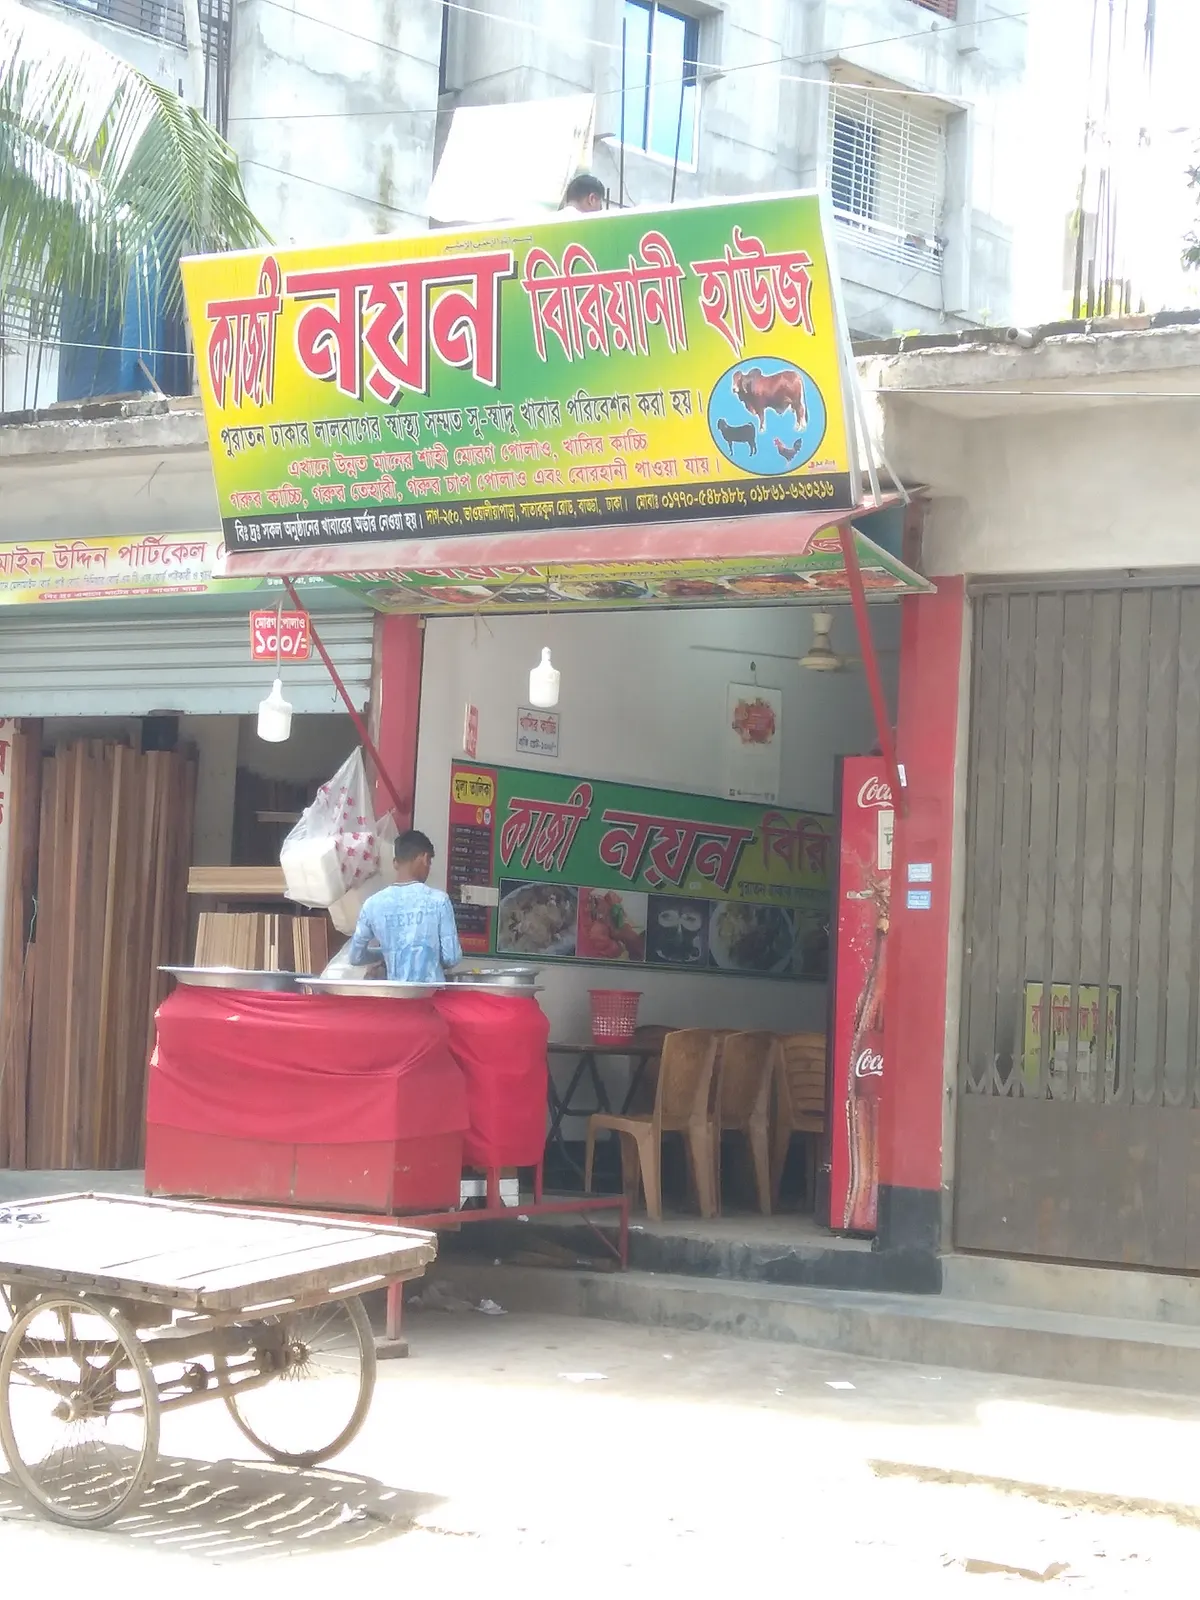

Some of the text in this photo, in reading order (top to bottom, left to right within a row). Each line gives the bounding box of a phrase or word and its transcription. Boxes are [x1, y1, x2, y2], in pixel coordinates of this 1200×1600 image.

[206, 225, 815, 409] কাজী নয়ন বিরিয়ানী হাউজ
[221, 425, 265, 457] পুরাতন
[269, 420, 310, 448] ঢাকার
[313, 416, 381, 446] লালবাগের
[384, 411, 420, 446] স্বাস্থ্য
[423, 408, 463, 438] সম্মত
[466, 402, 519, 439] সু-স্বাদু
[520, 398, 561, 430] খাবার
[567, 389, 631, 424] পরিবেশন
[636, 388, 665, 418] করা
[288, 456, 331, 479] এখানে
[334, 453, 368, 479] উন্নত
[370, 449, 413, 474] মানের
[416, 442, 449, 469] শাহী
[454, 444, 496, 466] মোরগ
[562, 433, 603, 457] খাসির
[609, 428, 648, 453] কাচ্চি
[229, 490, 262, 511] গরুর
[266, 482, 308, 510] কাচ্চি,
[312, 484, 345, 505] গরুর
[350, 475, 404, 504] তেহারী,
[406, 477, 442, 498] গরুর
[445, 473, 472, 494] চাপ
[477, 471, 527, 492] পোলাও
[534, 468, 563, 487] এবং
[568, 457, 628, 484] বোরহানী
[634, 459, 678, 480] পাওয়া
[53, 541, 109, 570] উদ্দিন
[118, 534, 208, 568] পার্টিকেল
[261, 521, 283, 541] সকল
[284, 514, 320, 543] অনুষ্ঠানের
[321, 516, 353, 537] খাবারের
[354, 509, 377, 534] অর্ডার
[378, 514, 403, 534] নেওয়া
[254, 616, 277, 629] মোরগ
[500, 782, 594, 872] কাজী
[599, 808, 757, 892] নয়ন
